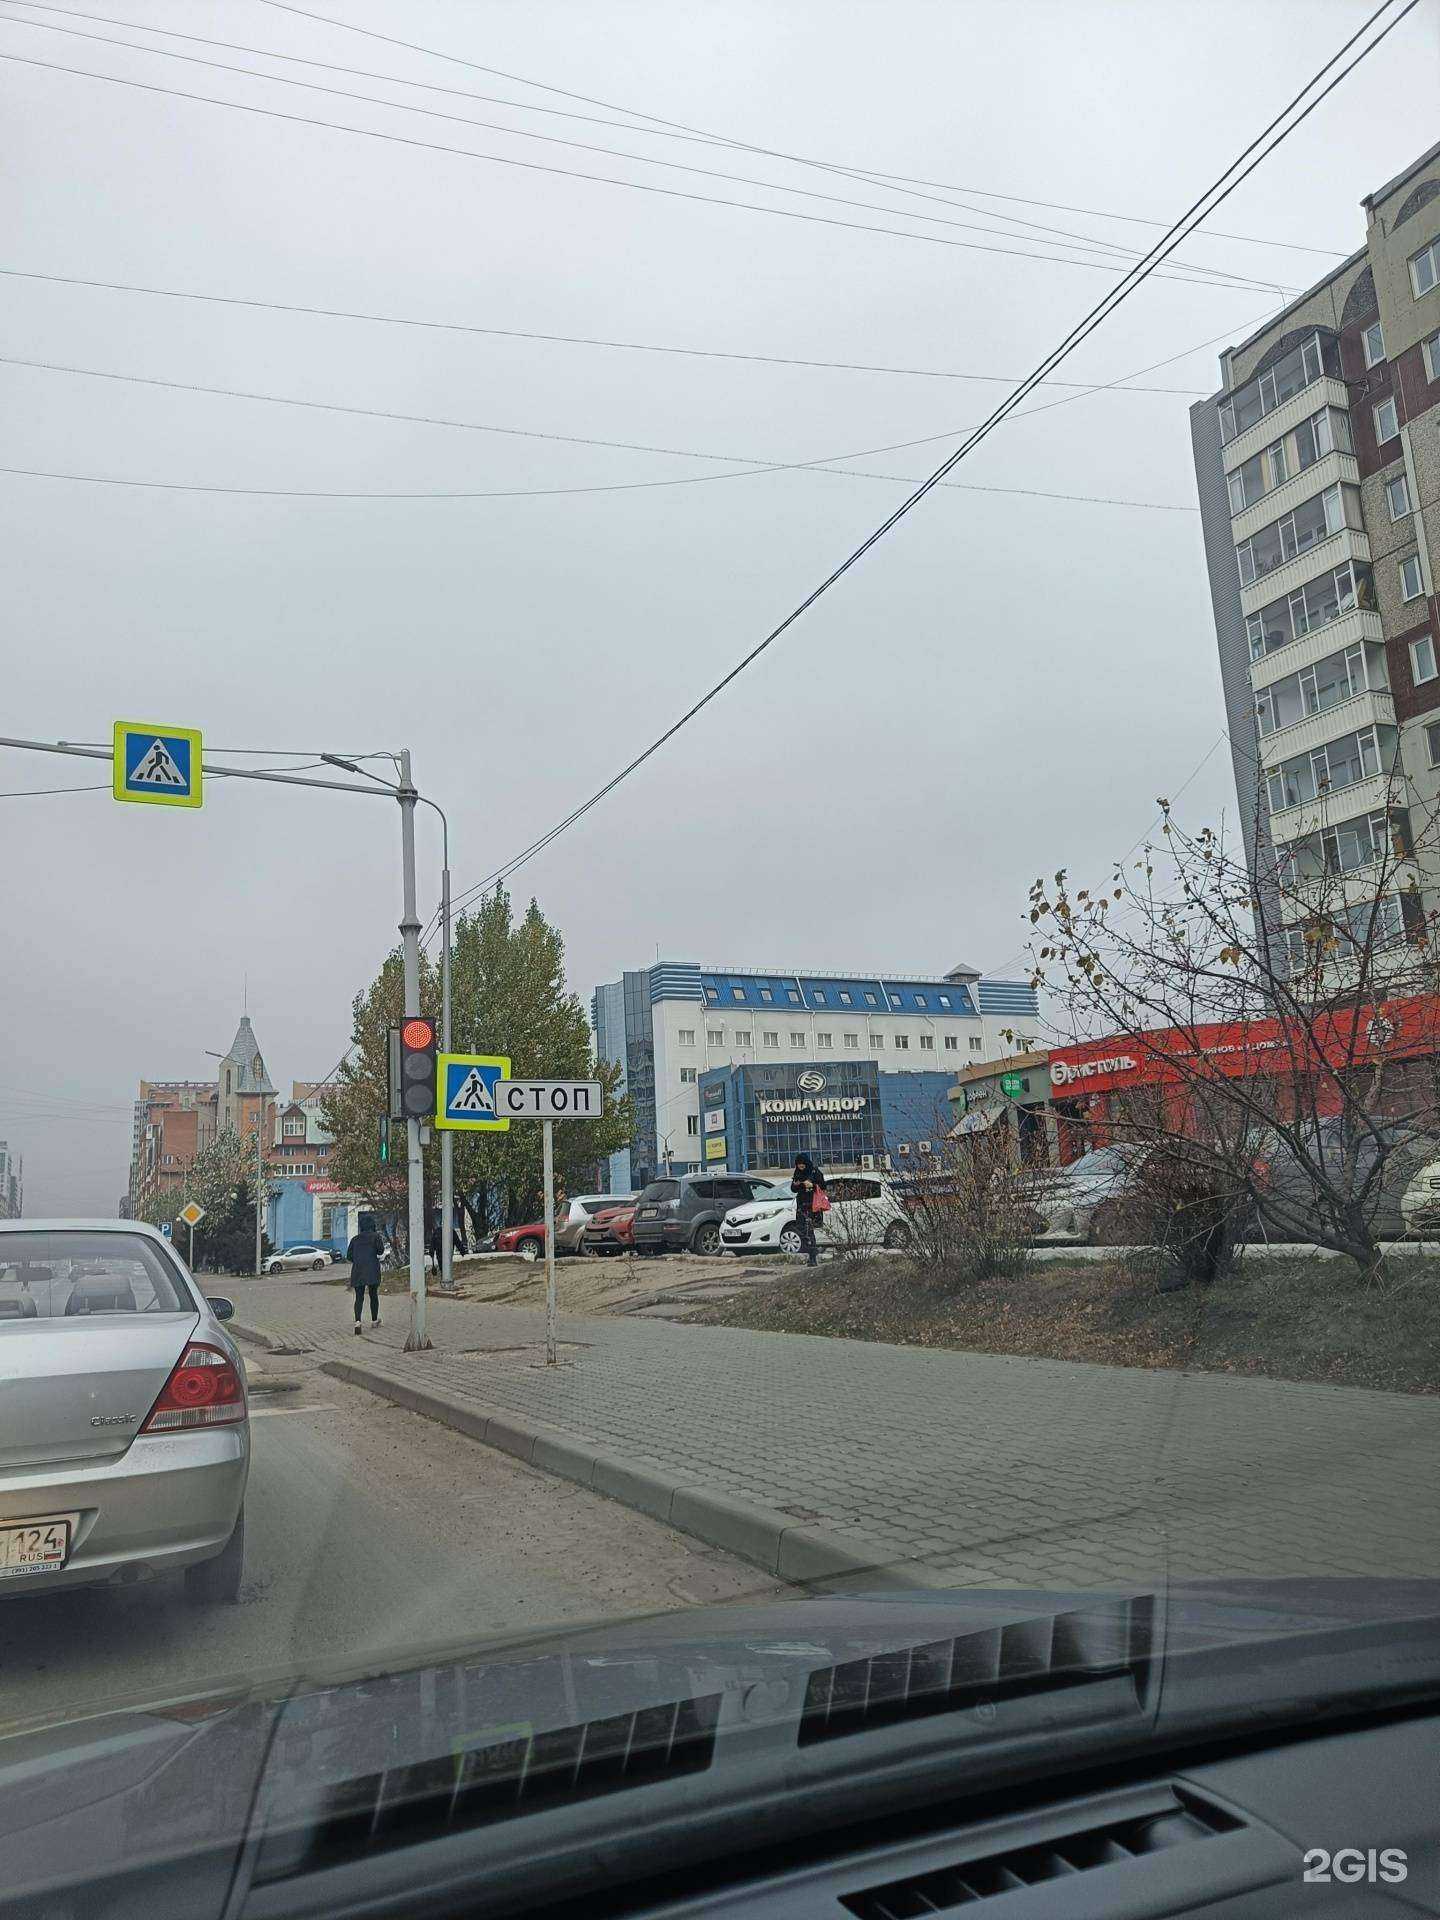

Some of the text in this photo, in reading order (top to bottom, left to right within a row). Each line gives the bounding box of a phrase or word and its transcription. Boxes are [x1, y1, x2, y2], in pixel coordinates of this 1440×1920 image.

[507, 1087, 590, 1111] СТОП
[760, 1097, 866, 1114] КОМАНДОР
[765, 1111, 865, 1123] ТОРГОВЫЙ КОМПЛЕКС
[15, 1527, 57, 1552] 124
[19, 1552, 43, 1562] RUS
